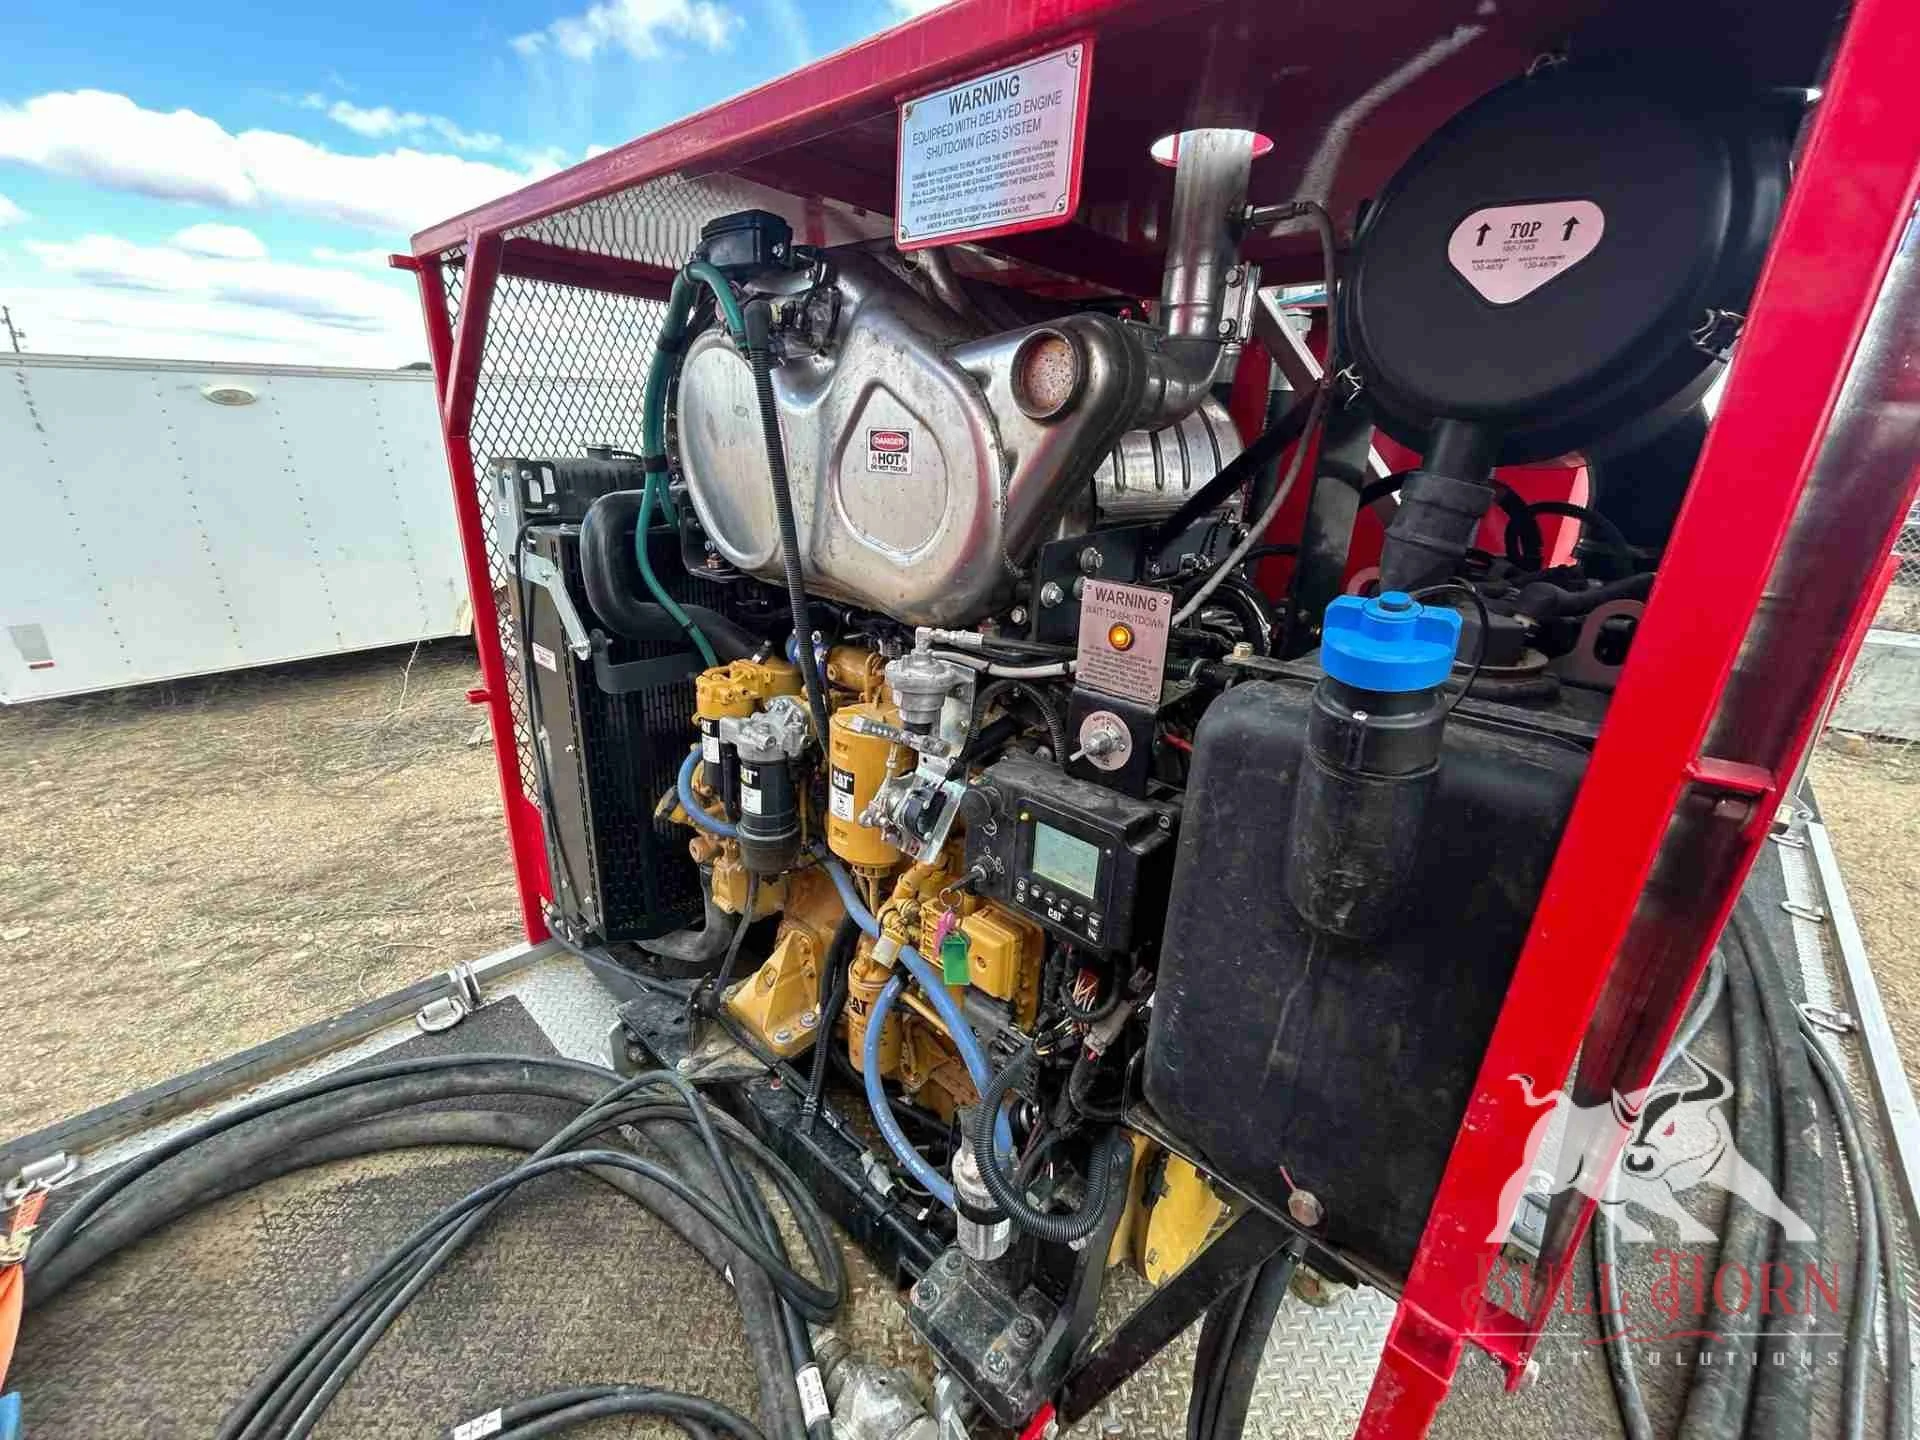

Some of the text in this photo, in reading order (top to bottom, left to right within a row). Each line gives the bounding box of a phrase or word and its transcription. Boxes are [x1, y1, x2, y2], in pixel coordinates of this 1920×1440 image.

[949, 75, 1020, 116] WARNING
[912, 90, 1063, 146] EQUIPPED WITH DELAYED ENGINE
[926, 118, 1041, 160] SHUTDOWN (DES) SYSTEM
[1510, 221, 1542, 239] TOP
[875, 437, 905, 447] DANGER
[878, 453, 902, 466] HOT
[1095, 587, 1158, 612] WARNING
[1086, 606, 1103, 617] WAIT
[1118, 611, 1165, 629] SHUTDOWN
[1048, 907, 1062, 922] CAT
